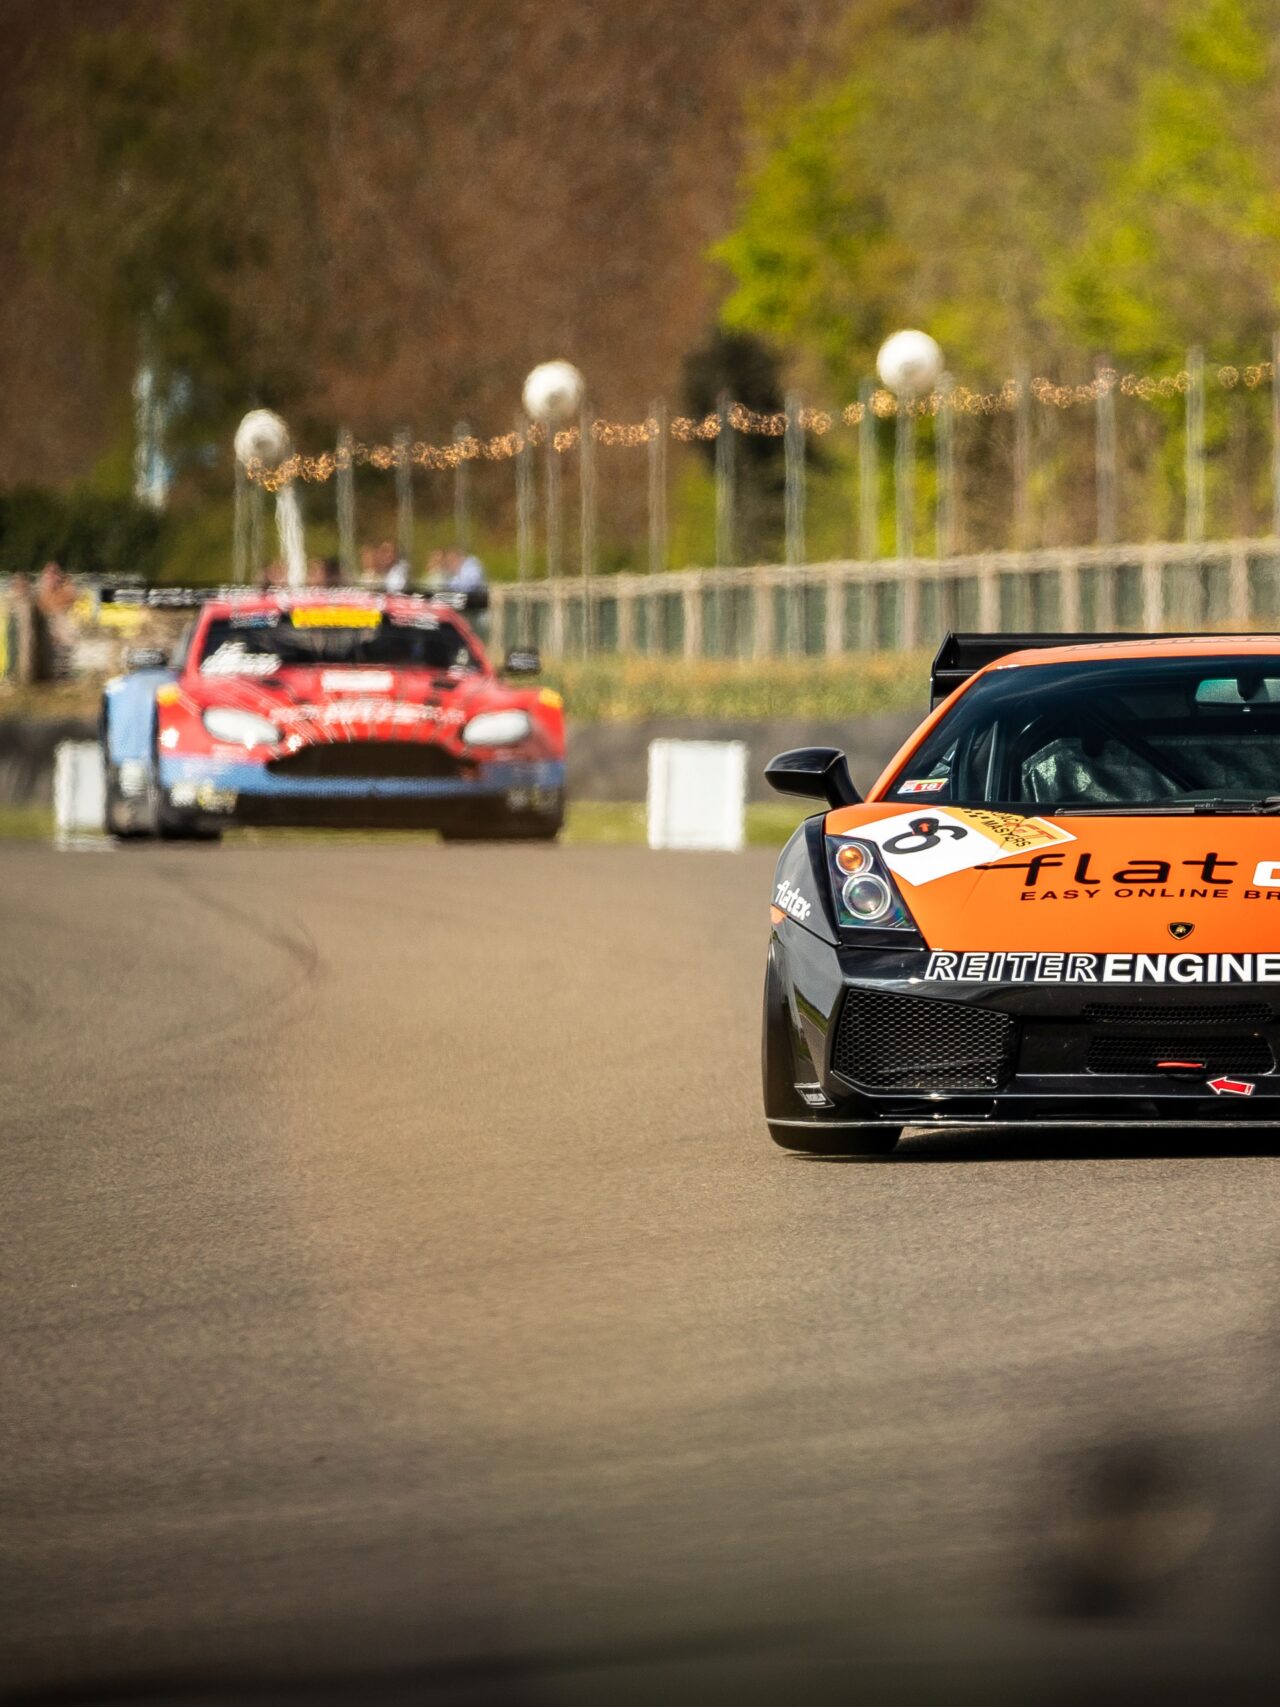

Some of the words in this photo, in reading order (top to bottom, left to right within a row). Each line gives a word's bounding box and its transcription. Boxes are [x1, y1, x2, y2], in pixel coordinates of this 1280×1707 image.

[1020, 889, 1101, 901] EASY
[1114, 888, 1229, 899] ONLINE
[924, 952, 1098, 982] REITER
